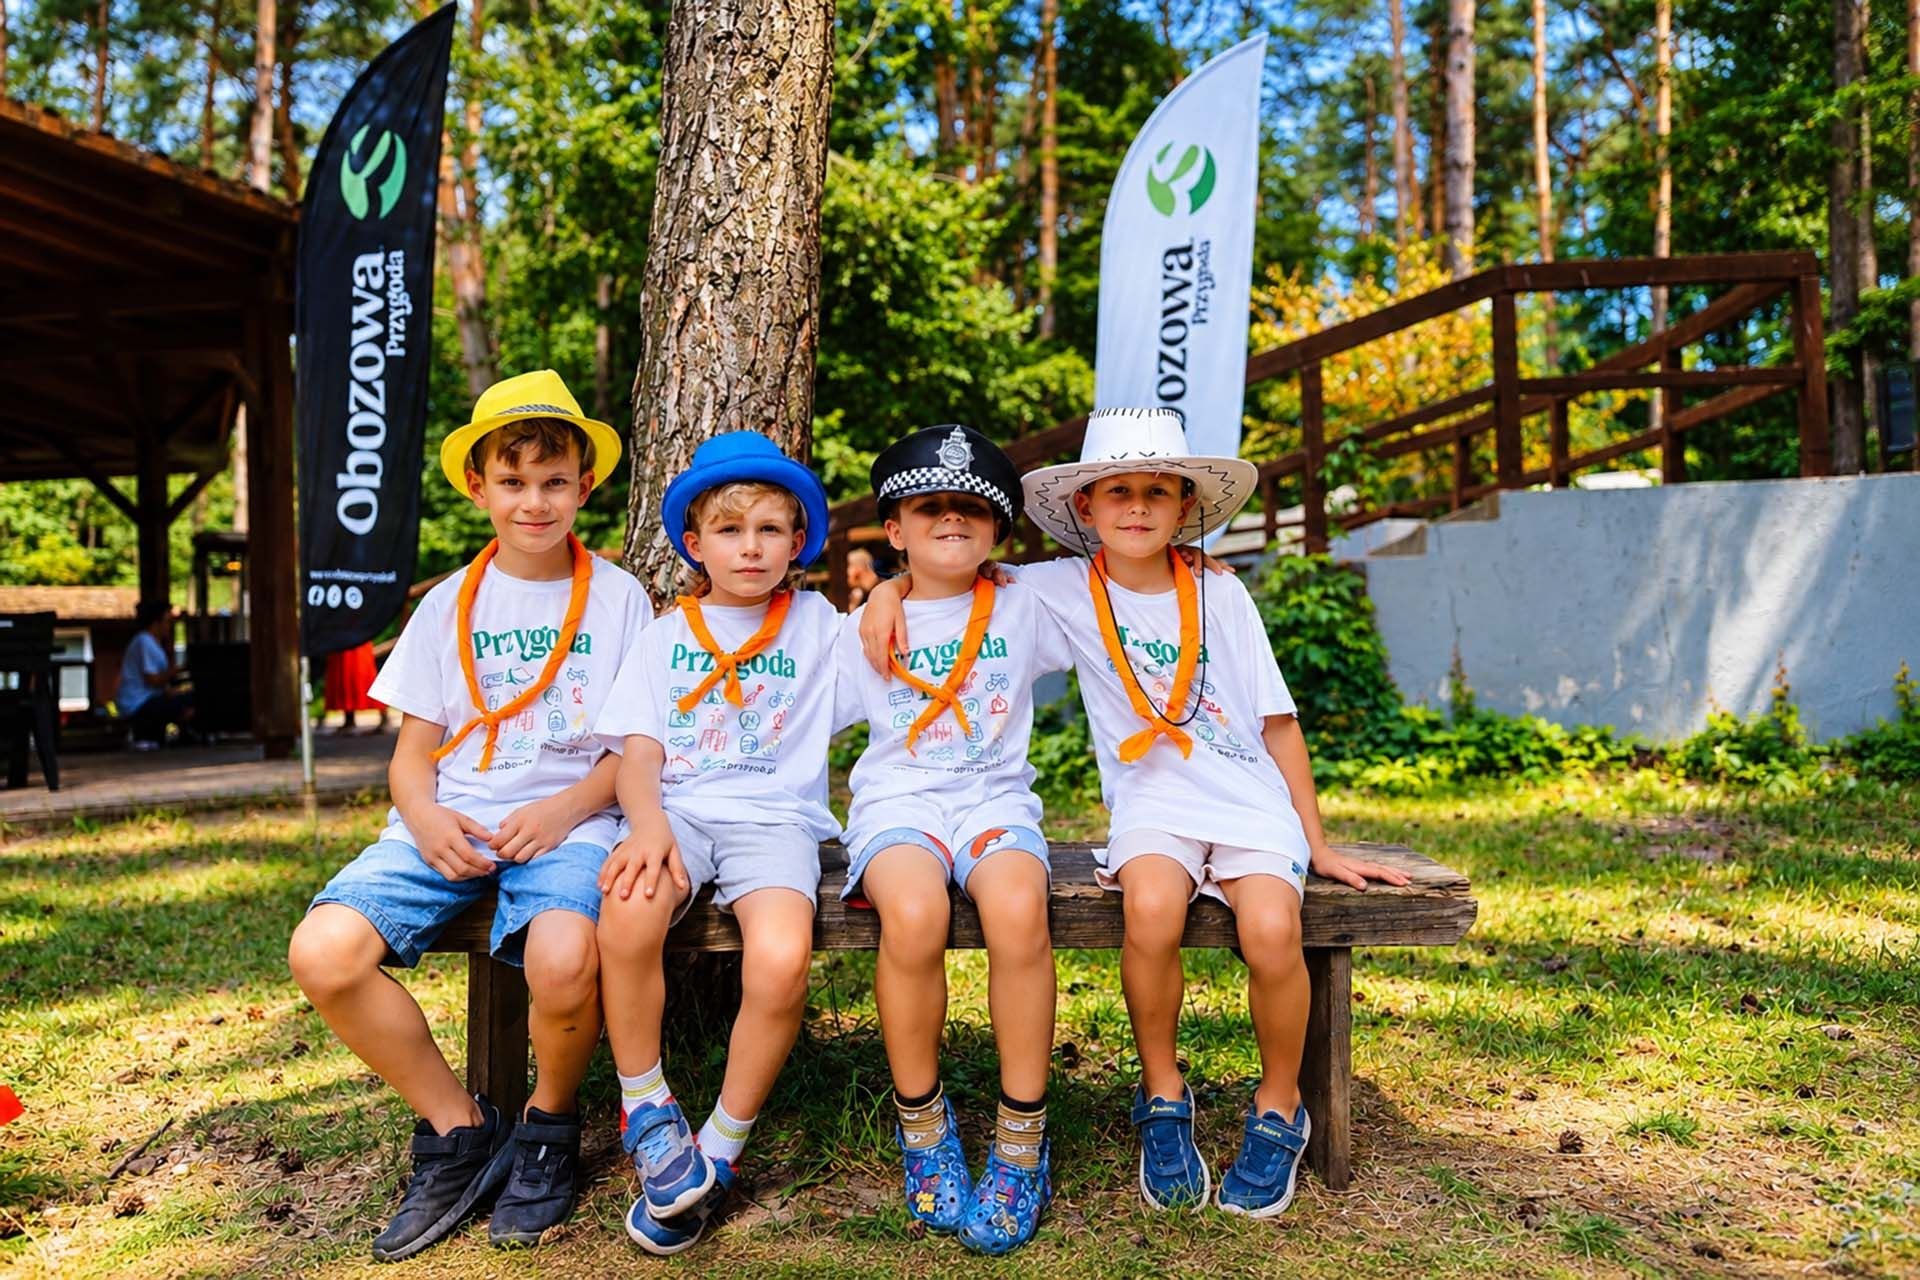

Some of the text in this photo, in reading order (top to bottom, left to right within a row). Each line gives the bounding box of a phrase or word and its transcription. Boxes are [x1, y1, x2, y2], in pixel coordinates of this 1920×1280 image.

[336, 251, 386, 536] Obozowa
[385, 249, 413, 357] Przygoda
[1156, 243, 1194, 432] ozowa
